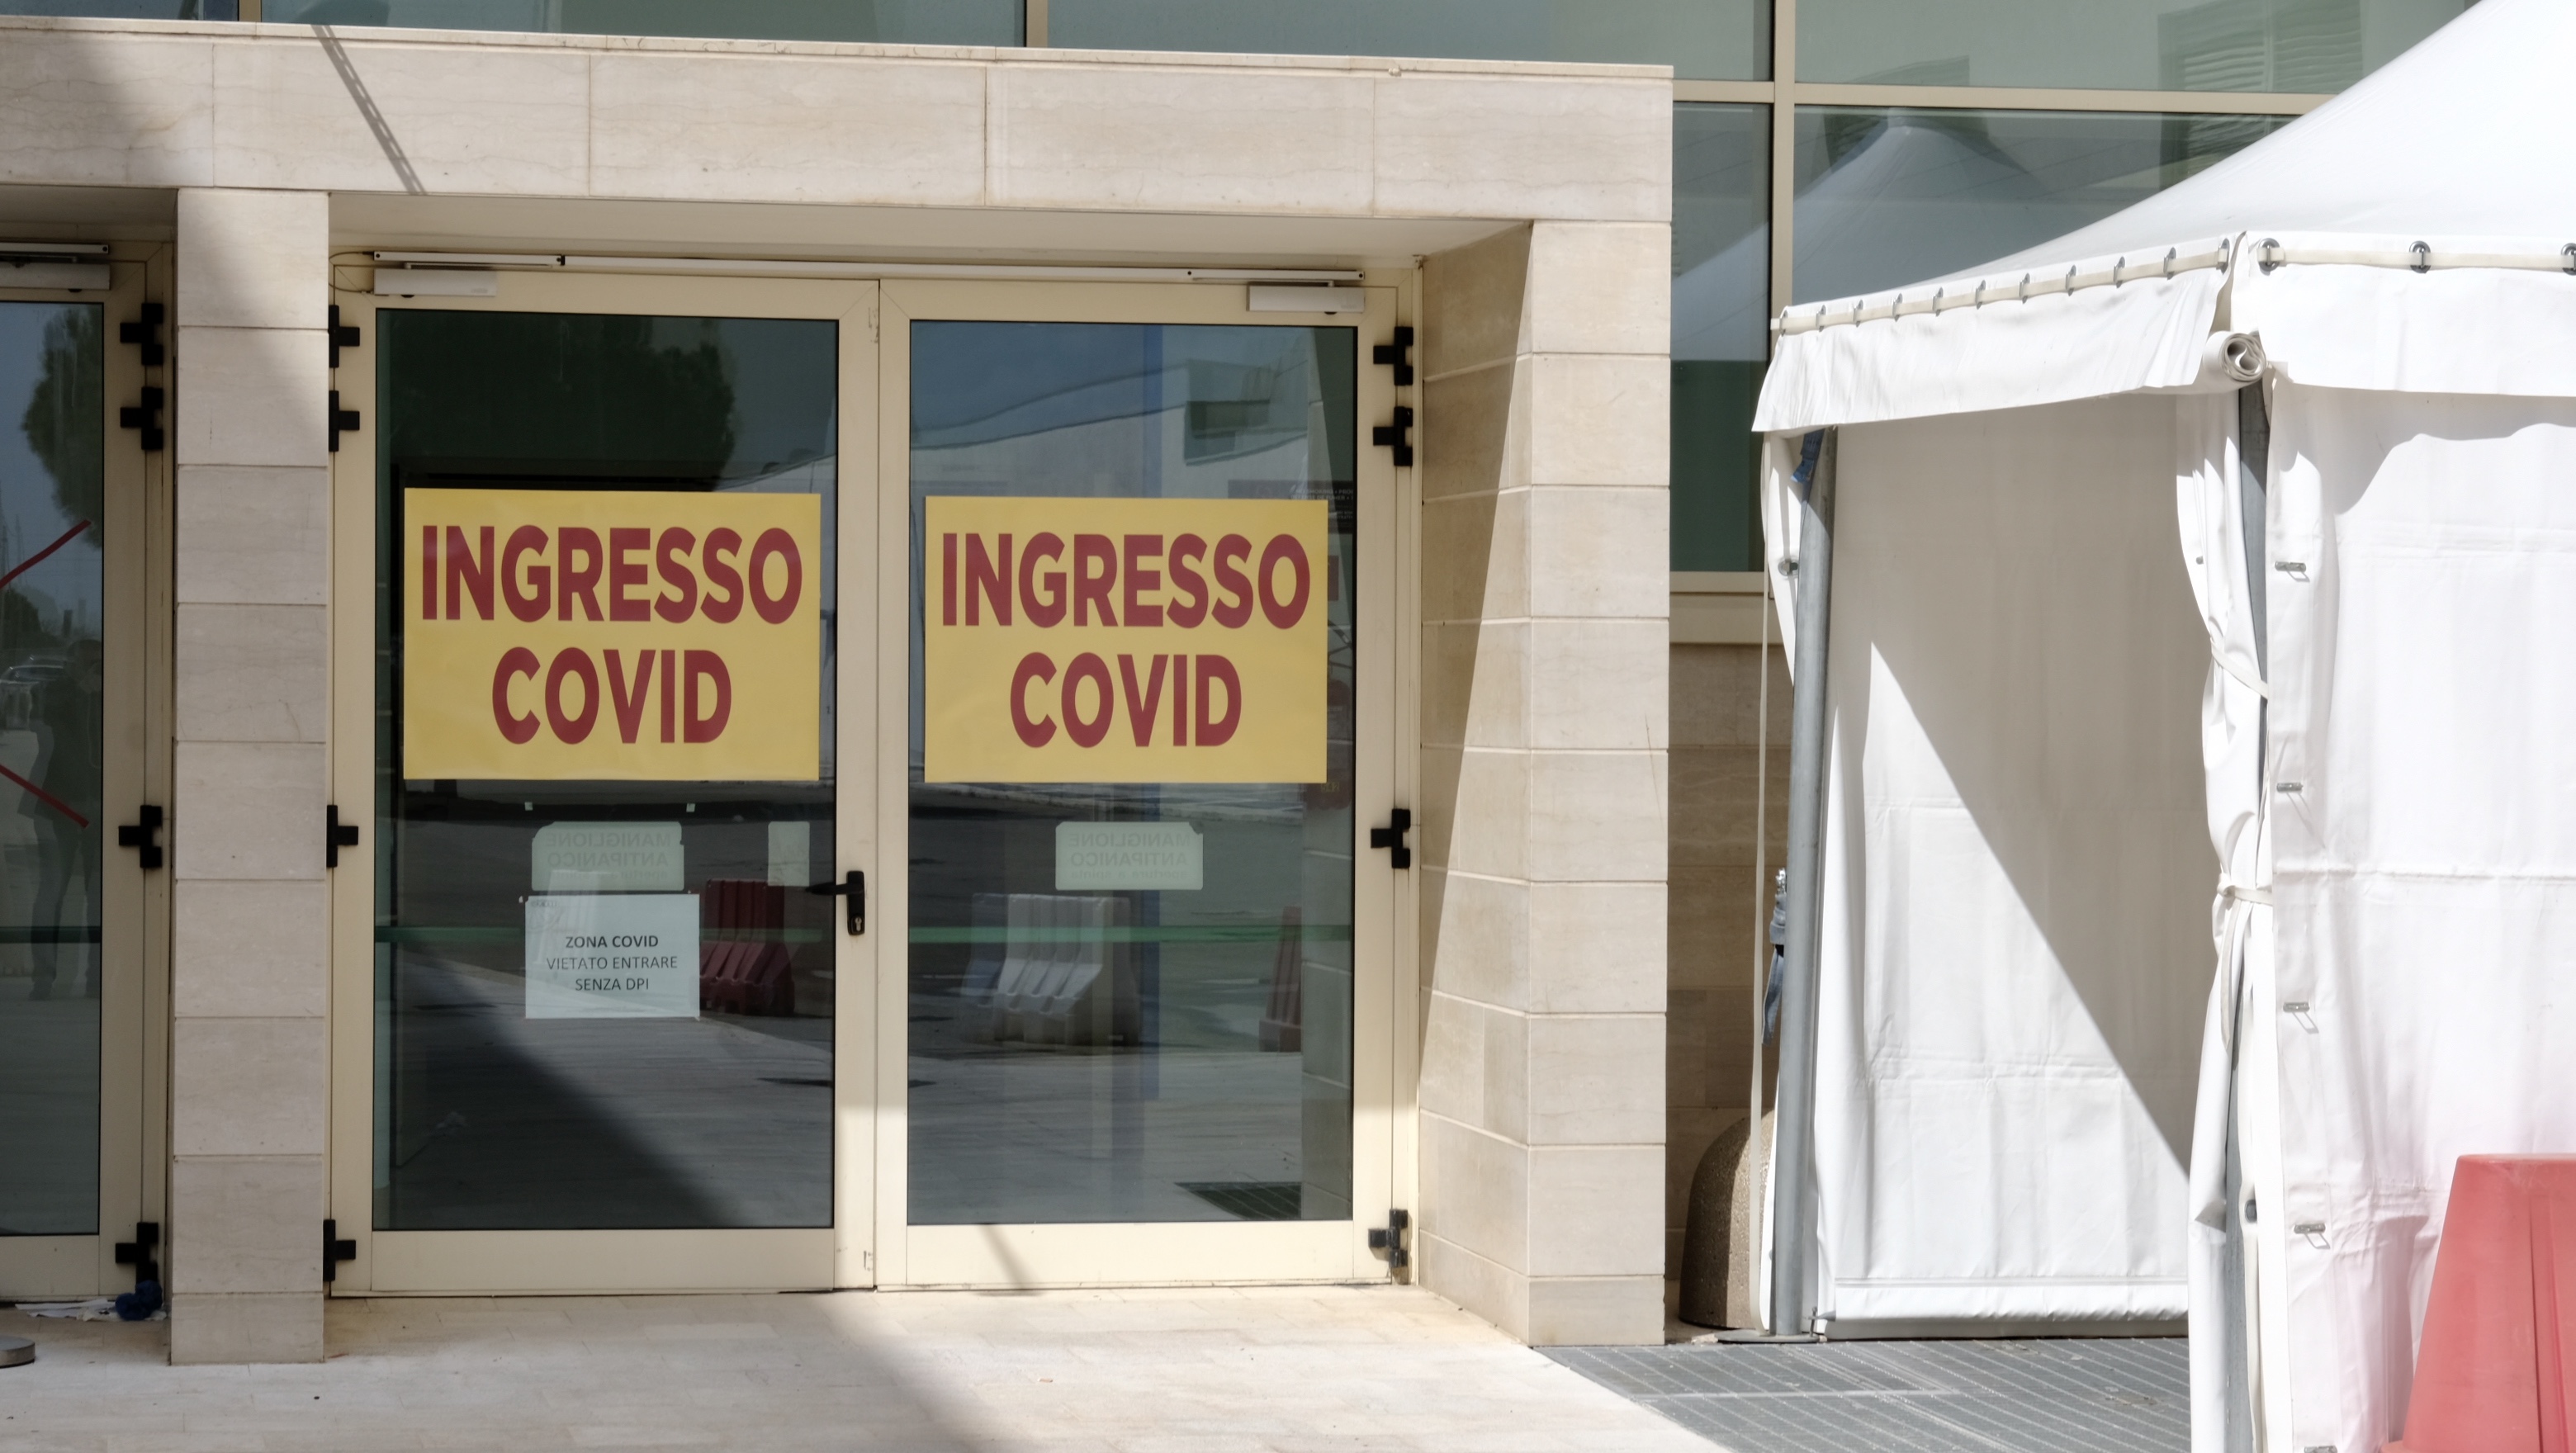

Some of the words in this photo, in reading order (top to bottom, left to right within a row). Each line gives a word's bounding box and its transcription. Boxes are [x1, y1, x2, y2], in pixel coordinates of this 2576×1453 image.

[423, 524, 803, 625] INGRESSO
[943, 532, 1310, 630] INGRESSO
[492, 646, 732, 745] COVID
[1010, 651, 1242, 748] COVID
[547, 956, 608, 970] VIETATO
[613, 955, 678, 969] ENTRARE
[566, 935, 608, 949] ZONA
[612, 935, 659, 949] COVID
[575, 977, 621, 992] SENZA
[625, 977, 649, 991] DPI
